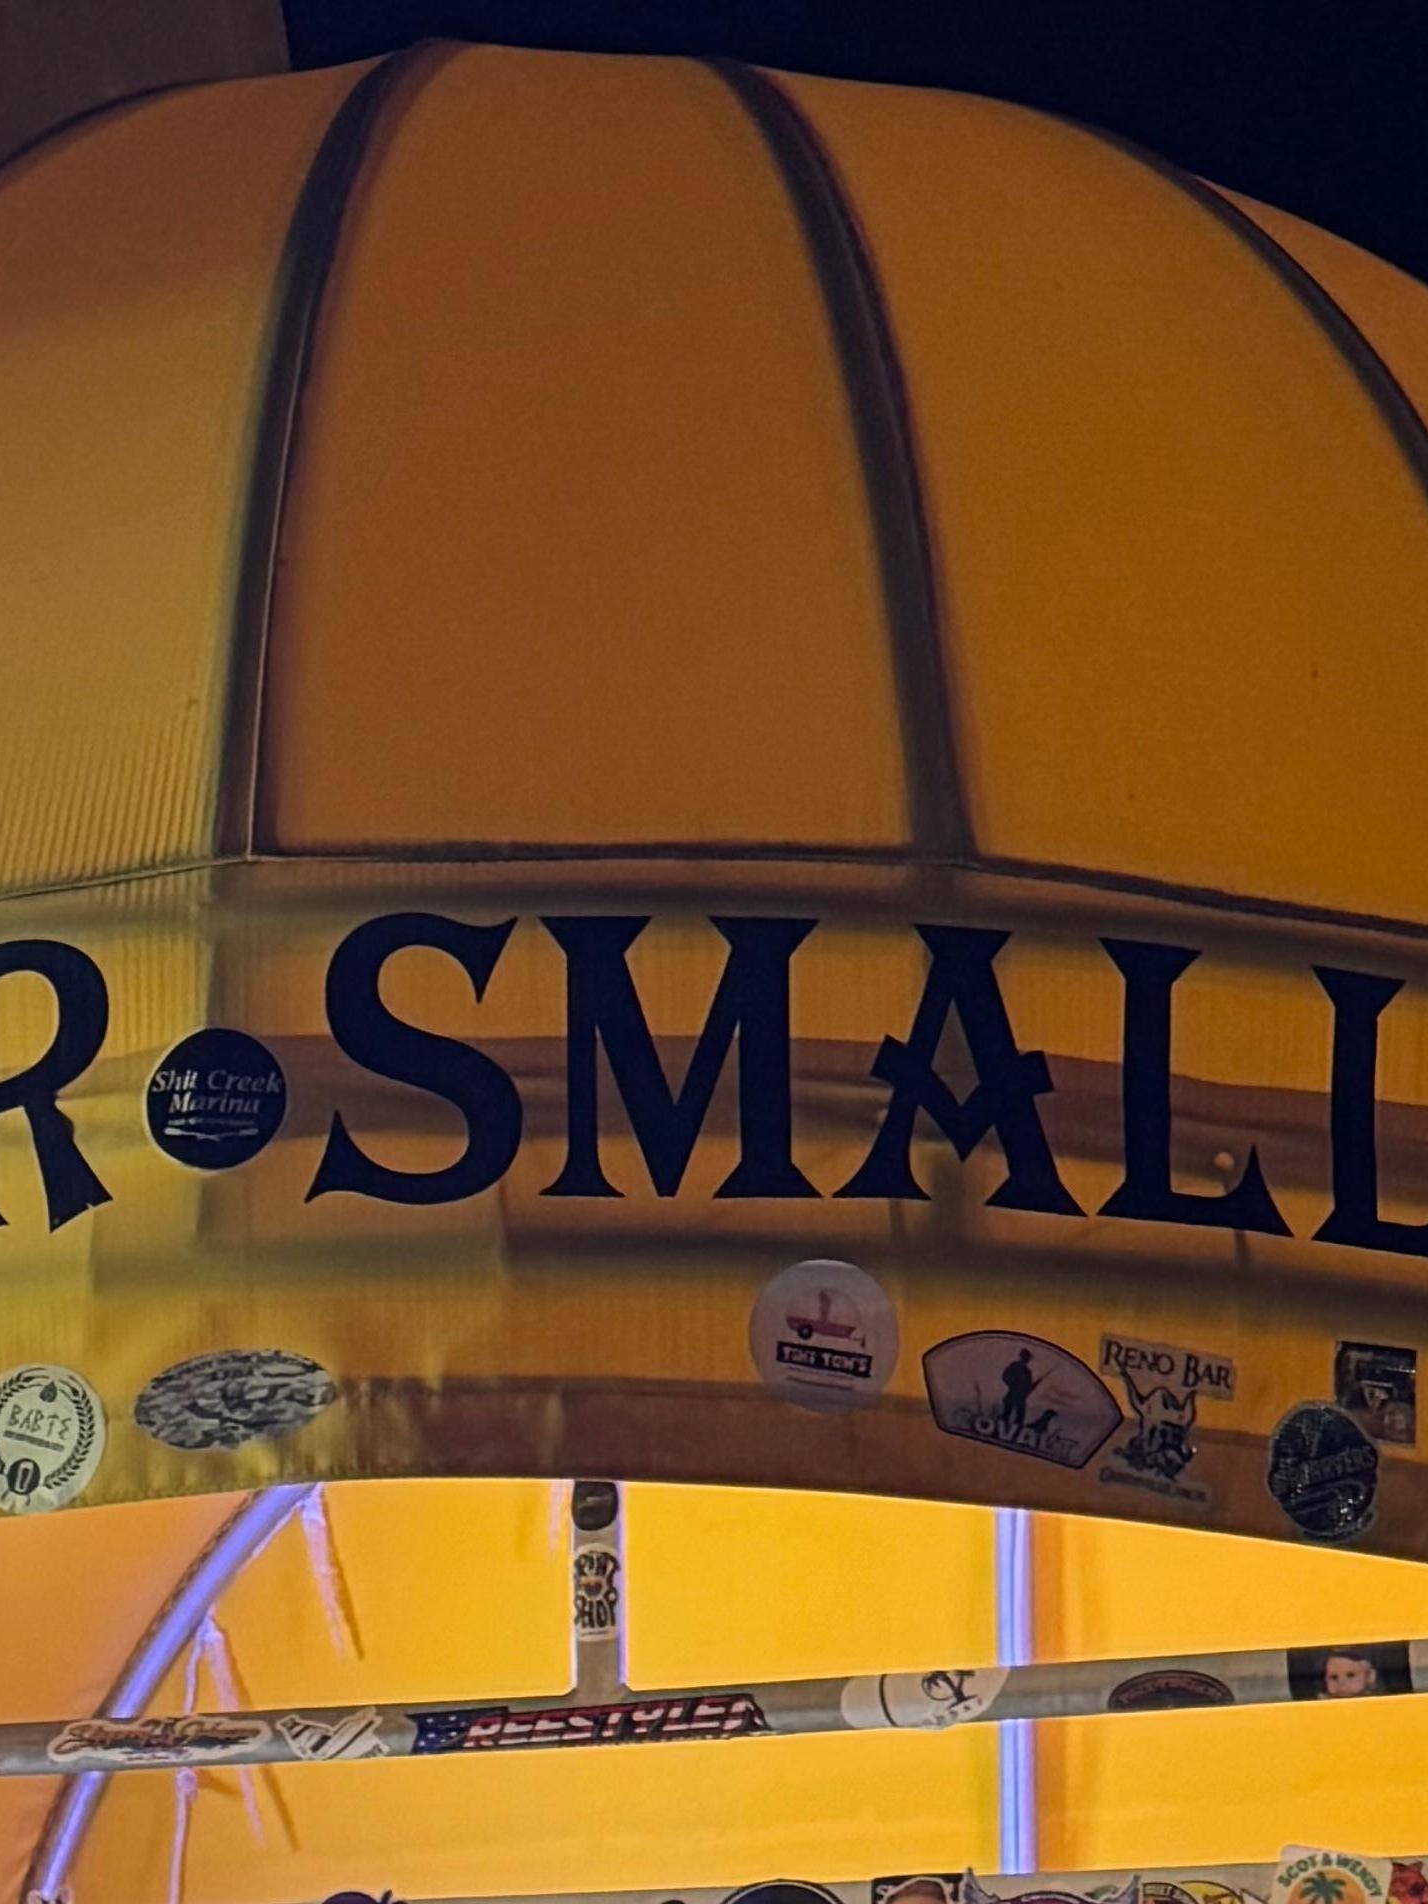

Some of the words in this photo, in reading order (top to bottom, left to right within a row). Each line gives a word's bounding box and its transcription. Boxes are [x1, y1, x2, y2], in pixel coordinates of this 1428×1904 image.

[207, 1070, 282, 1093] Creek
[169, 1092, 259, 1113] Marina
[1103, 1337, 1174, 1376] RENO
[1181, 1354, 1234, 1390] BAR
